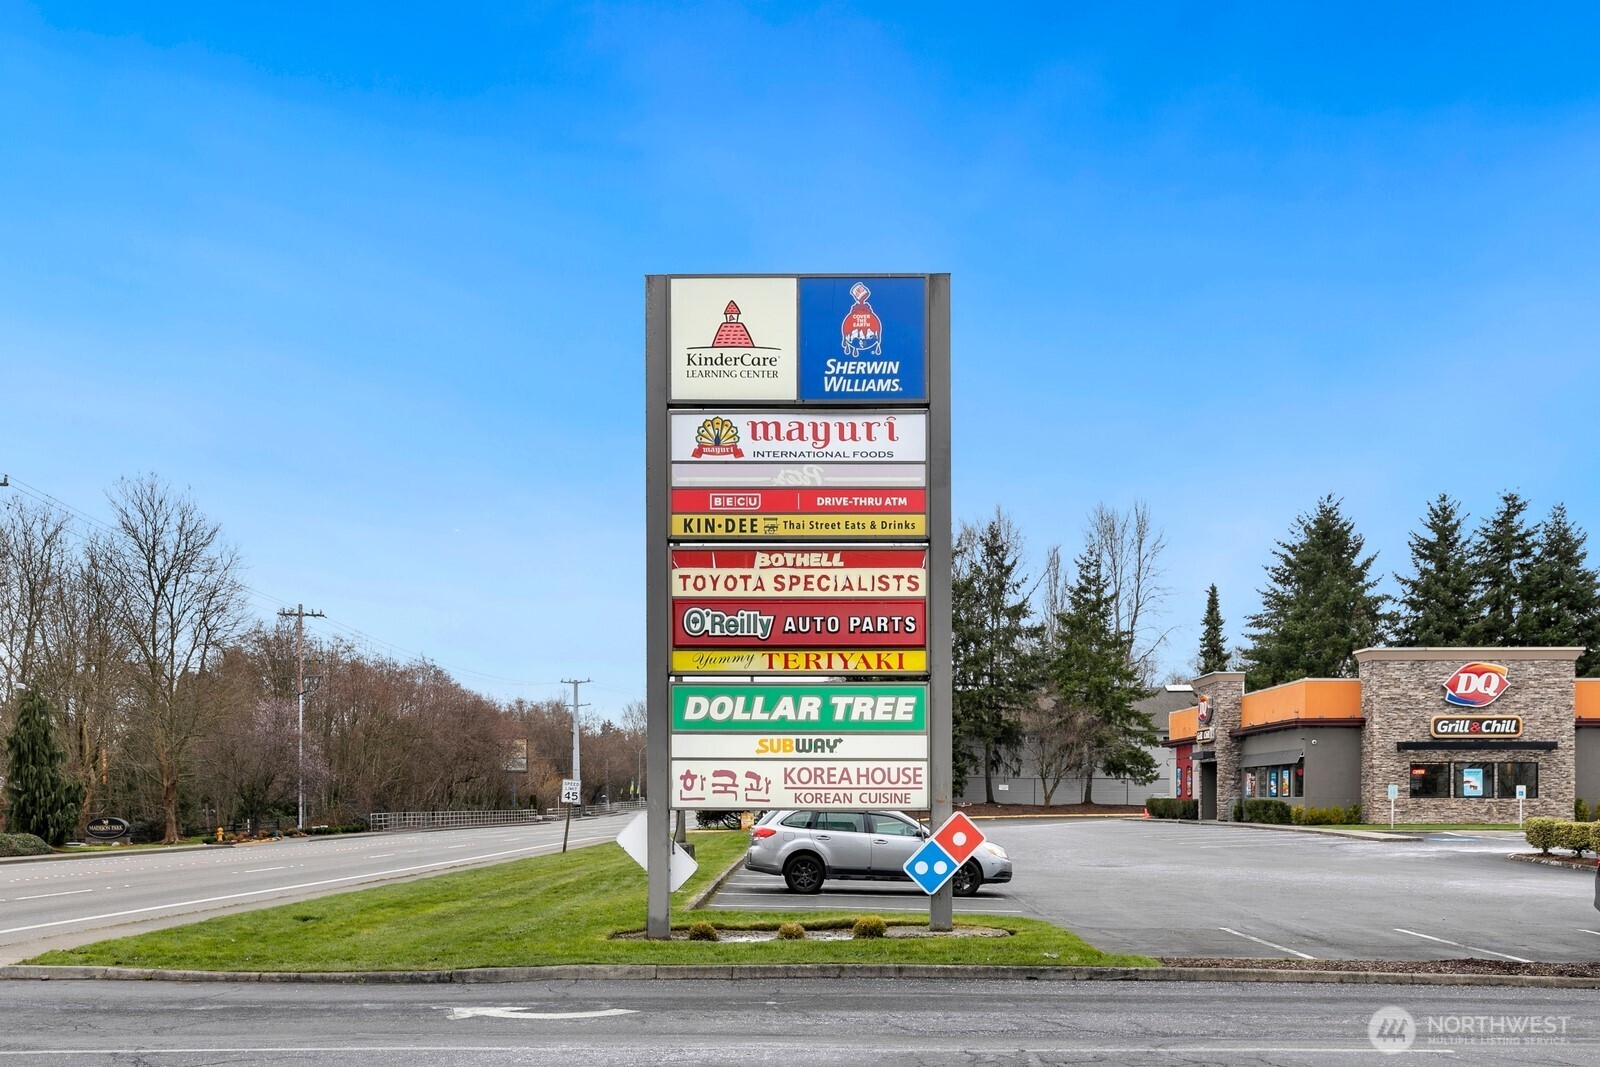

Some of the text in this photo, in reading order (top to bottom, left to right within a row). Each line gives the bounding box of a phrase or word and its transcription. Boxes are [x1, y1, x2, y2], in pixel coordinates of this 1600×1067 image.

[687, 353, 778, 367] KinderCare
[825, 359, 899, 375] SHERWIN
[687, 370, 778, 378] LEARNING CENTER
[824, 376, 900, 392] WILLIAMS
[713, 496, 908, 507] BECU DRIVE-THRU ATM
[783, 520, 805, 530] Thai
[809, 520, 841, 530] Street
[845, 520, 866, 530] Eats
[869, 520, 877, 530] &
[880, 520, 916, 530] Drinks
[757, 552, 844, 567] BOTHELL
[678, 574, 920, 592] TOYOTA SPECIALISTS
[684, 608, 917, 639] O'Reilly AUTO PARTS
[692, 652, 905, 670] Yummy TERIYAKI
[1455, 672, 1500, 696] DQ
[684, 696, 917, 721] DOLLAR TREE
[1437, 720, 1470, 733] Grill
[1481, 720, 1517, 733] Chill
[755, 737, 843, 754] SUBWAY
[783, 767, 923, 785] KOREA HOUSE
[564, 791, 578, 800] 45
[794, 793, 911, 804] KOREAN CUISINE
